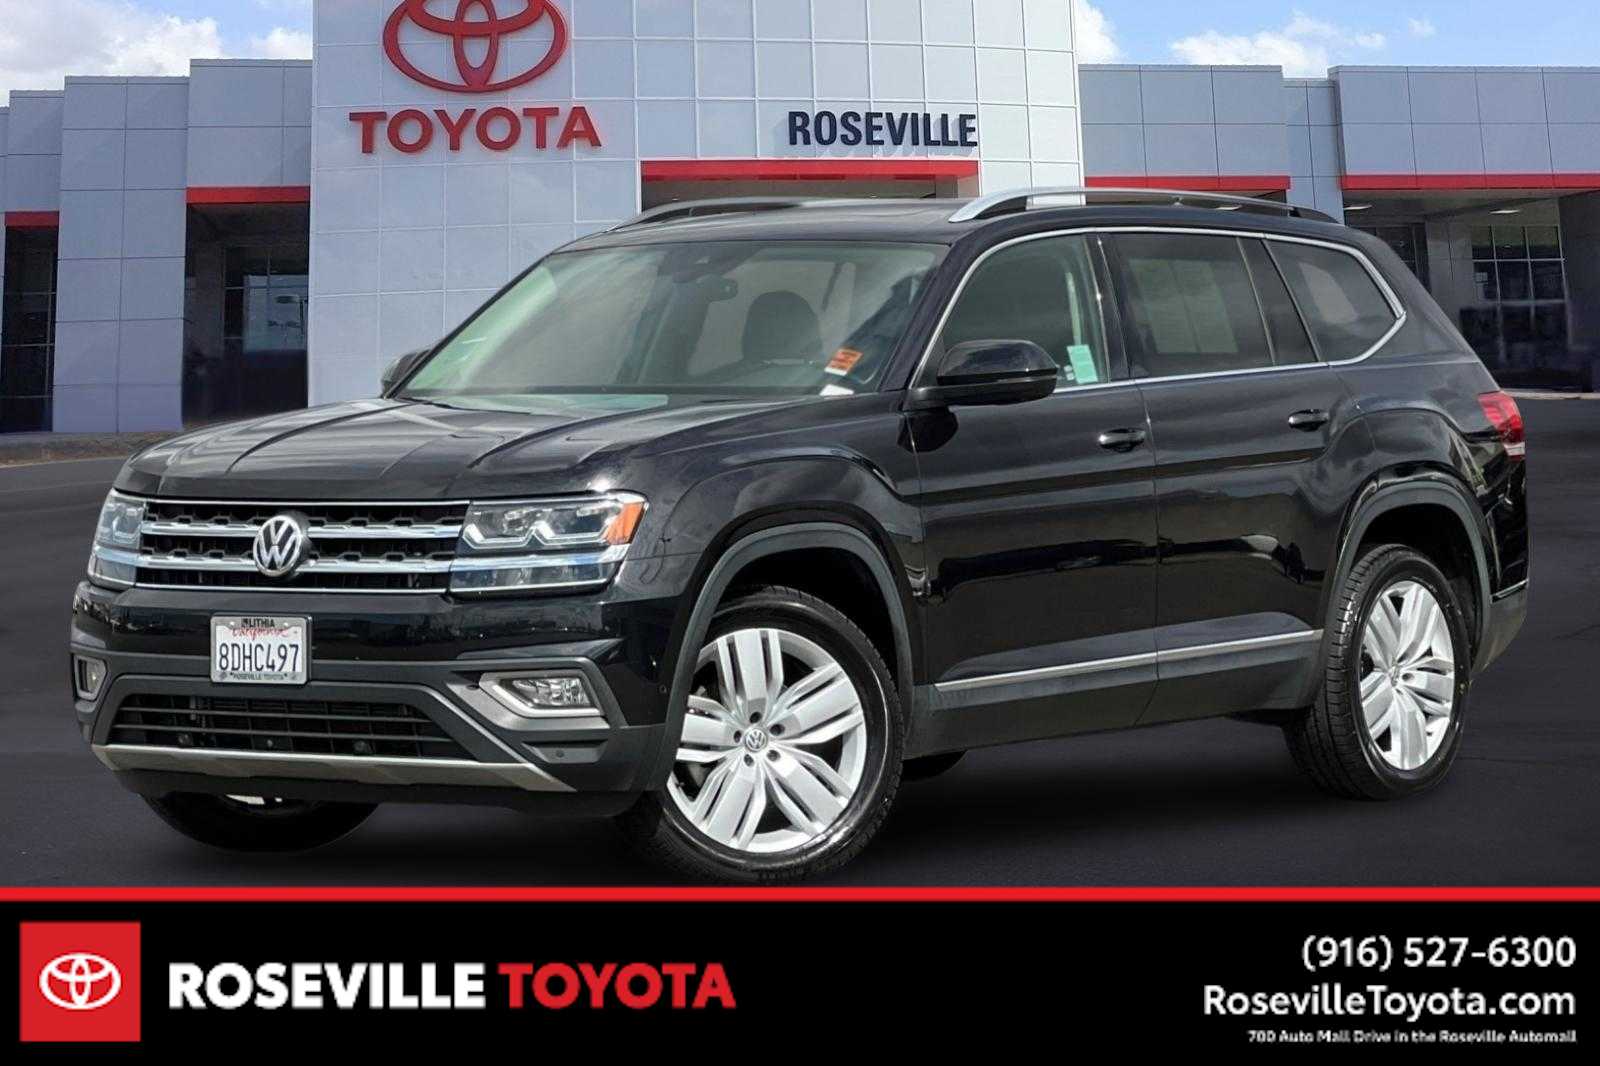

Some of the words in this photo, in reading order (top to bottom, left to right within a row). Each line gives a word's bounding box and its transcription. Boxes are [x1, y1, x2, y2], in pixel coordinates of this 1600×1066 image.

[350, 106, 602, 154] TOYOTA
[788, 111, 978, 147] ROSEVILLE
[249, 618, 275, 628] LITHIA
[219, 643, 299, 671] 8DHC497
